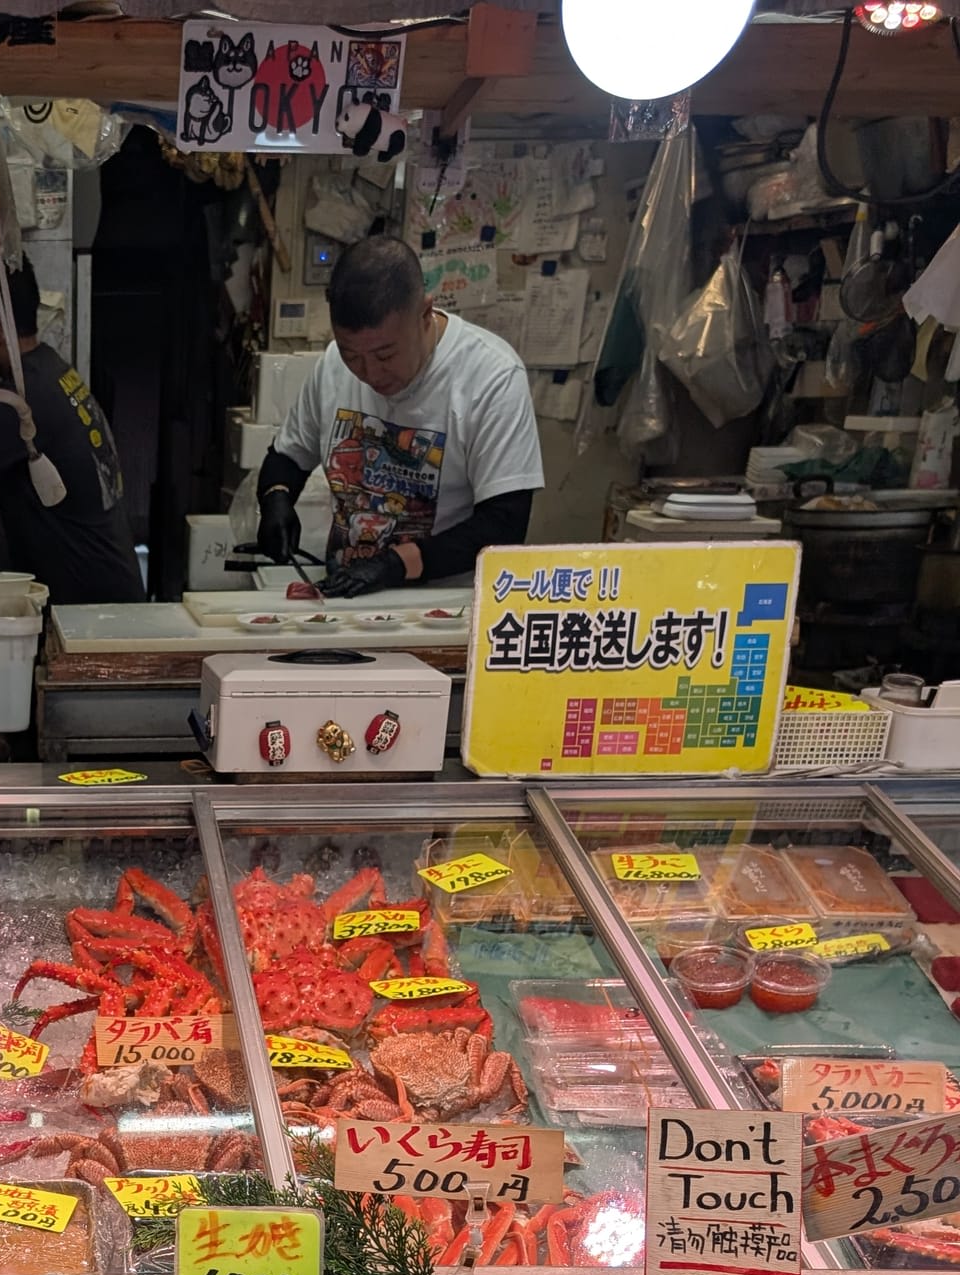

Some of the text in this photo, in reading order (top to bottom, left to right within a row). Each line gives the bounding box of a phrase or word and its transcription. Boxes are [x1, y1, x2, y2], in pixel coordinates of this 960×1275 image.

[264, 39, 343, 64] APAN
[489, 610, 728, 668] 全国発送します!
[748, 926, 804, 941] いくら
[346, 1125, 532, 1171] いくら寿司
[658, 1118, 786, 1165] Don't
[802, 1123, 960, 1198] 本まぐろ
[667, 1171, 794, 1214] Touch
